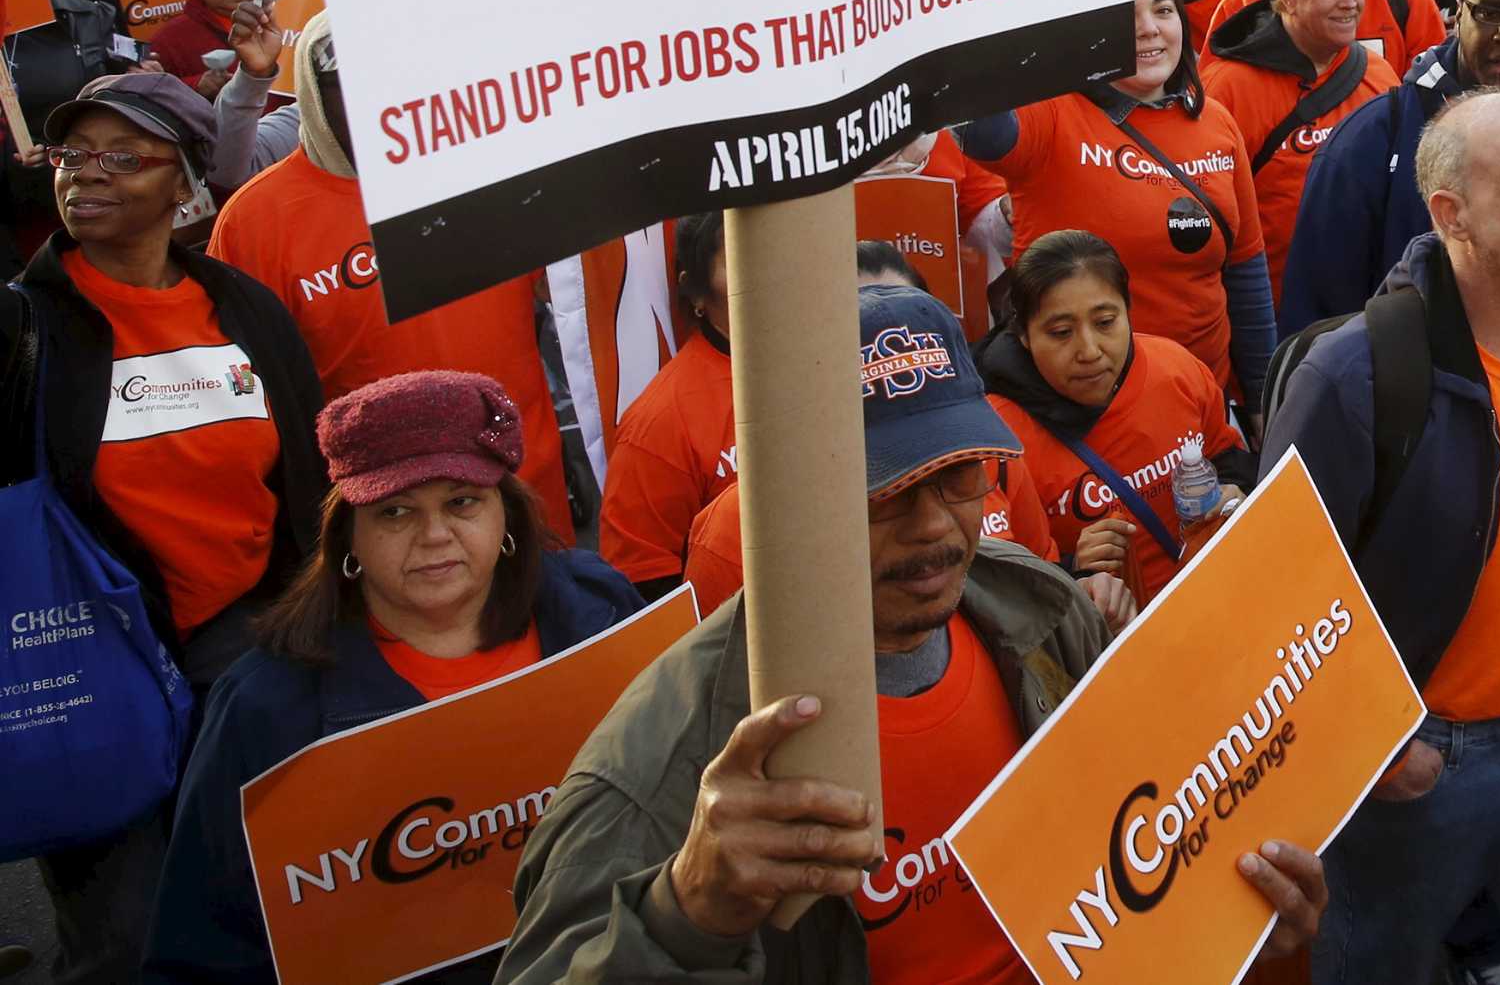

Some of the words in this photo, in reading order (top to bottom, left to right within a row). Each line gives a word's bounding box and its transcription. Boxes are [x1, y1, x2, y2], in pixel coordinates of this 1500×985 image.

[380, 78, 507, 165] STAND
[509, 59, 564, 118] UP
[569, 39, 652, 108] FOR
[657, 20, 760, 87] JOBS
[763, 3, 852, 71] THAT
[1080, 142, 1113, 167] NY
[1115, 143, 1235, 181] Comunities
[1168, 216, 1211, 230] #FightFor15
[299, 264, 342, 302] NY
[112, 385, 123, 400] Y
[121, 376, 222, 402] Communities
[3, 683, 29, 697] YOU
[1046, 865, 1120, 980] NY
[1109, 598, 1354, 913] Communities
[1176, 822, 1211, 869] for
[1213, 719, 1297, 820] Change
[283, 837, 369, 904] NY
[449, 839, 493, 871] for
[912, 879, 944, 914] for
